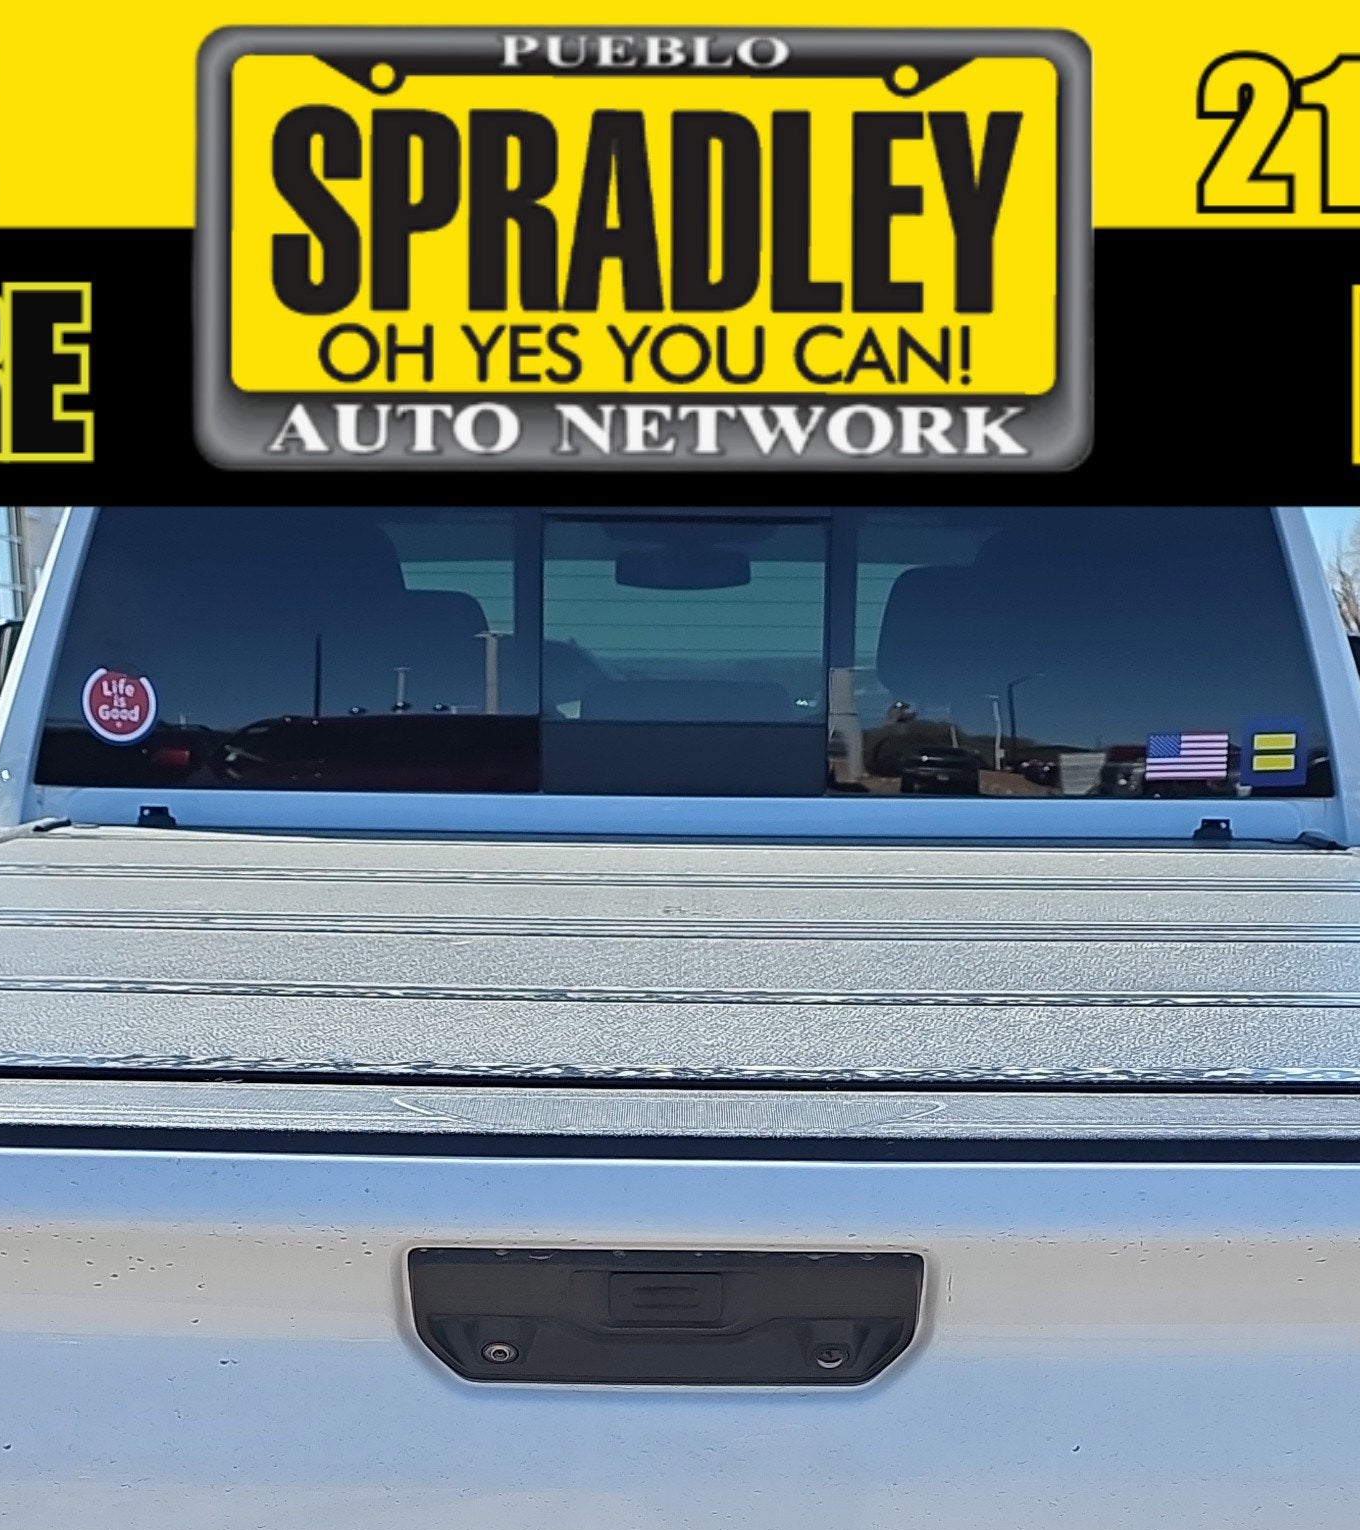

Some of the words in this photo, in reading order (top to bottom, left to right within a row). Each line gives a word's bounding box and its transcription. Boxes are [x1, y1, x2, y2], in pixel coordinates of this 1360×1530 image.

[102, 678, 135, 697] Life
[113, 694, 127, 708] is
[98, 704, 140, 722] Good
